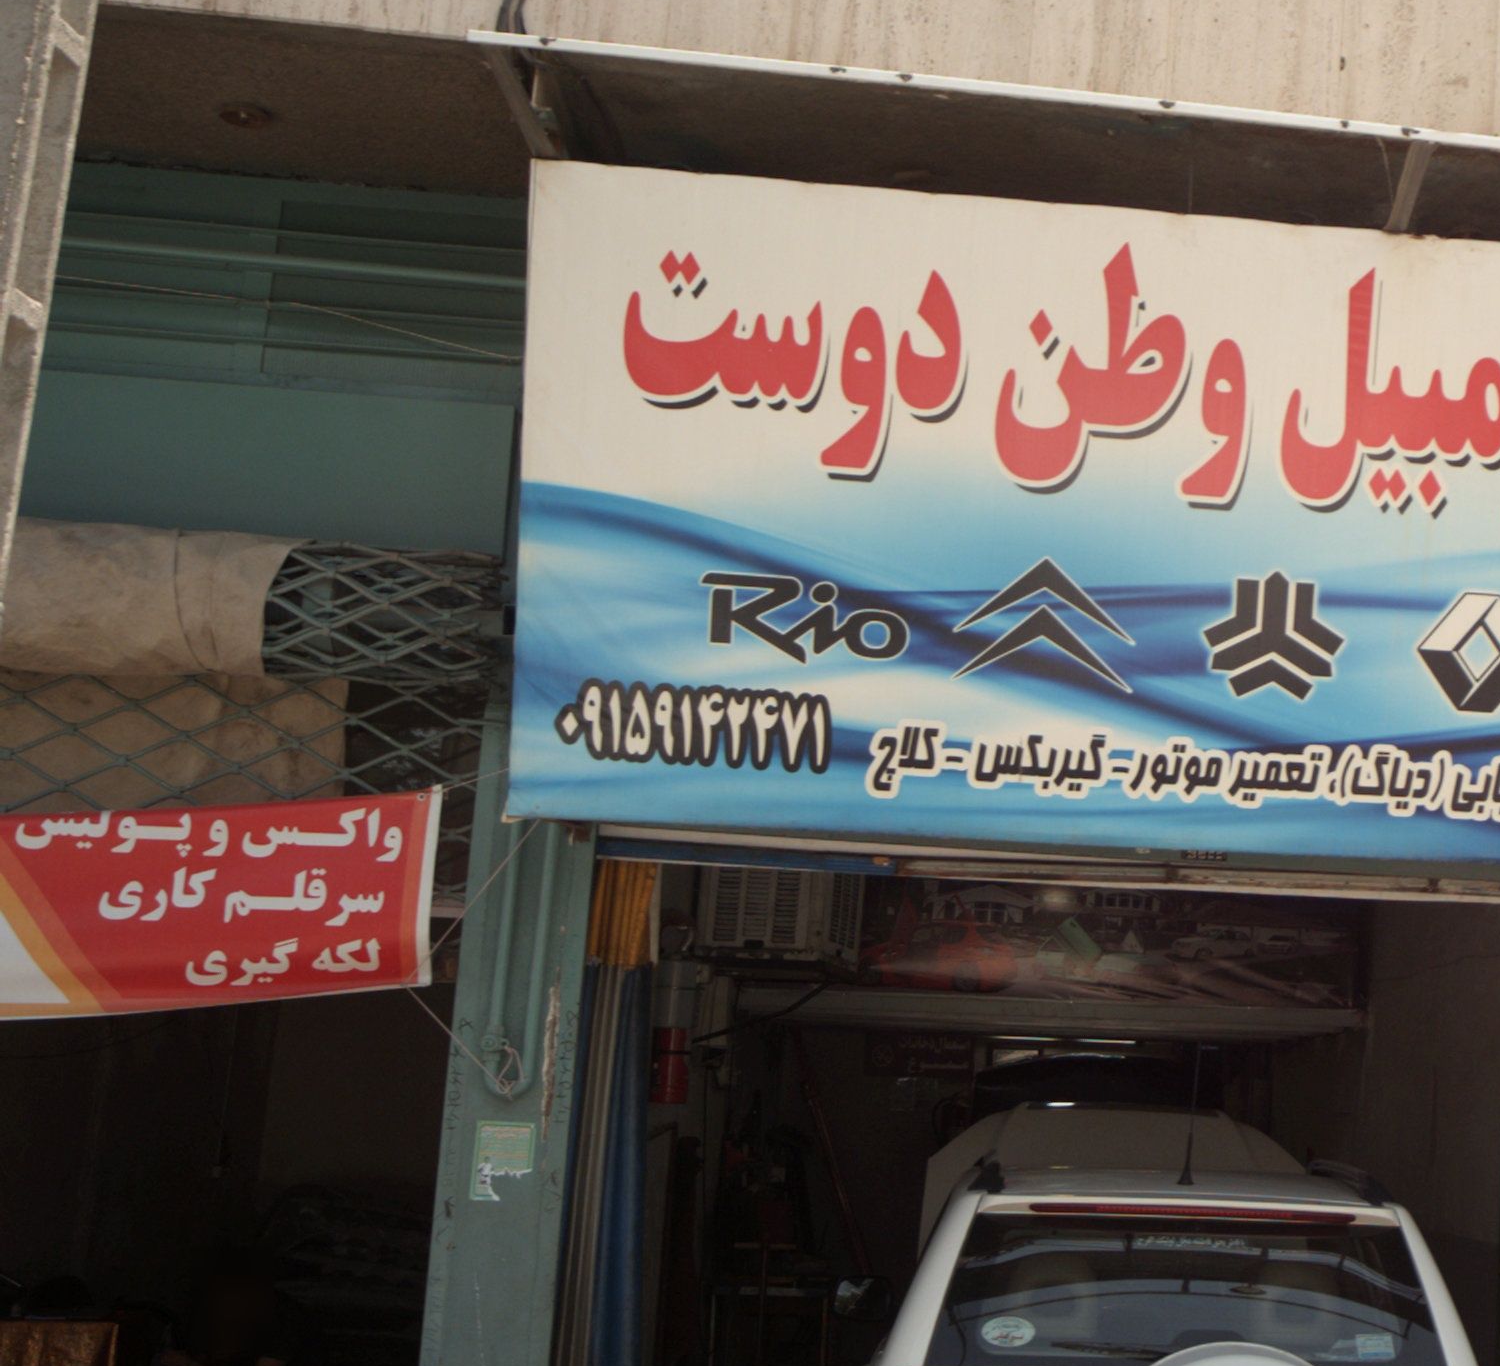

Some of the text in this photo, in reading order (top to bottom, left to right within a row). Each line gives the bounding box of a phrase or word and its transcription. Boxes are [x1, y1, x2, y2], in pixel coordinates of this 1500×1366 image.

[622, 249, 964, 471] دوست
[994, 242, 1248, 499] وطن
[702, 572, 908, 664] Rio
[557, 681, 830, 772] ۰۹۱۵۹۱۴۲۴۷۱
[873, 726, 940, 792] کلاچ
[975, 733, 1107, 792] گیربکس
[1228, 751, 1323, 802] تعمیر
[202, 818, 230, 857] و
[240, 807, 403, 863] واکس
[98, 866, 217, 922] کاری
[186, 937, 381, 986] لکه گیری
